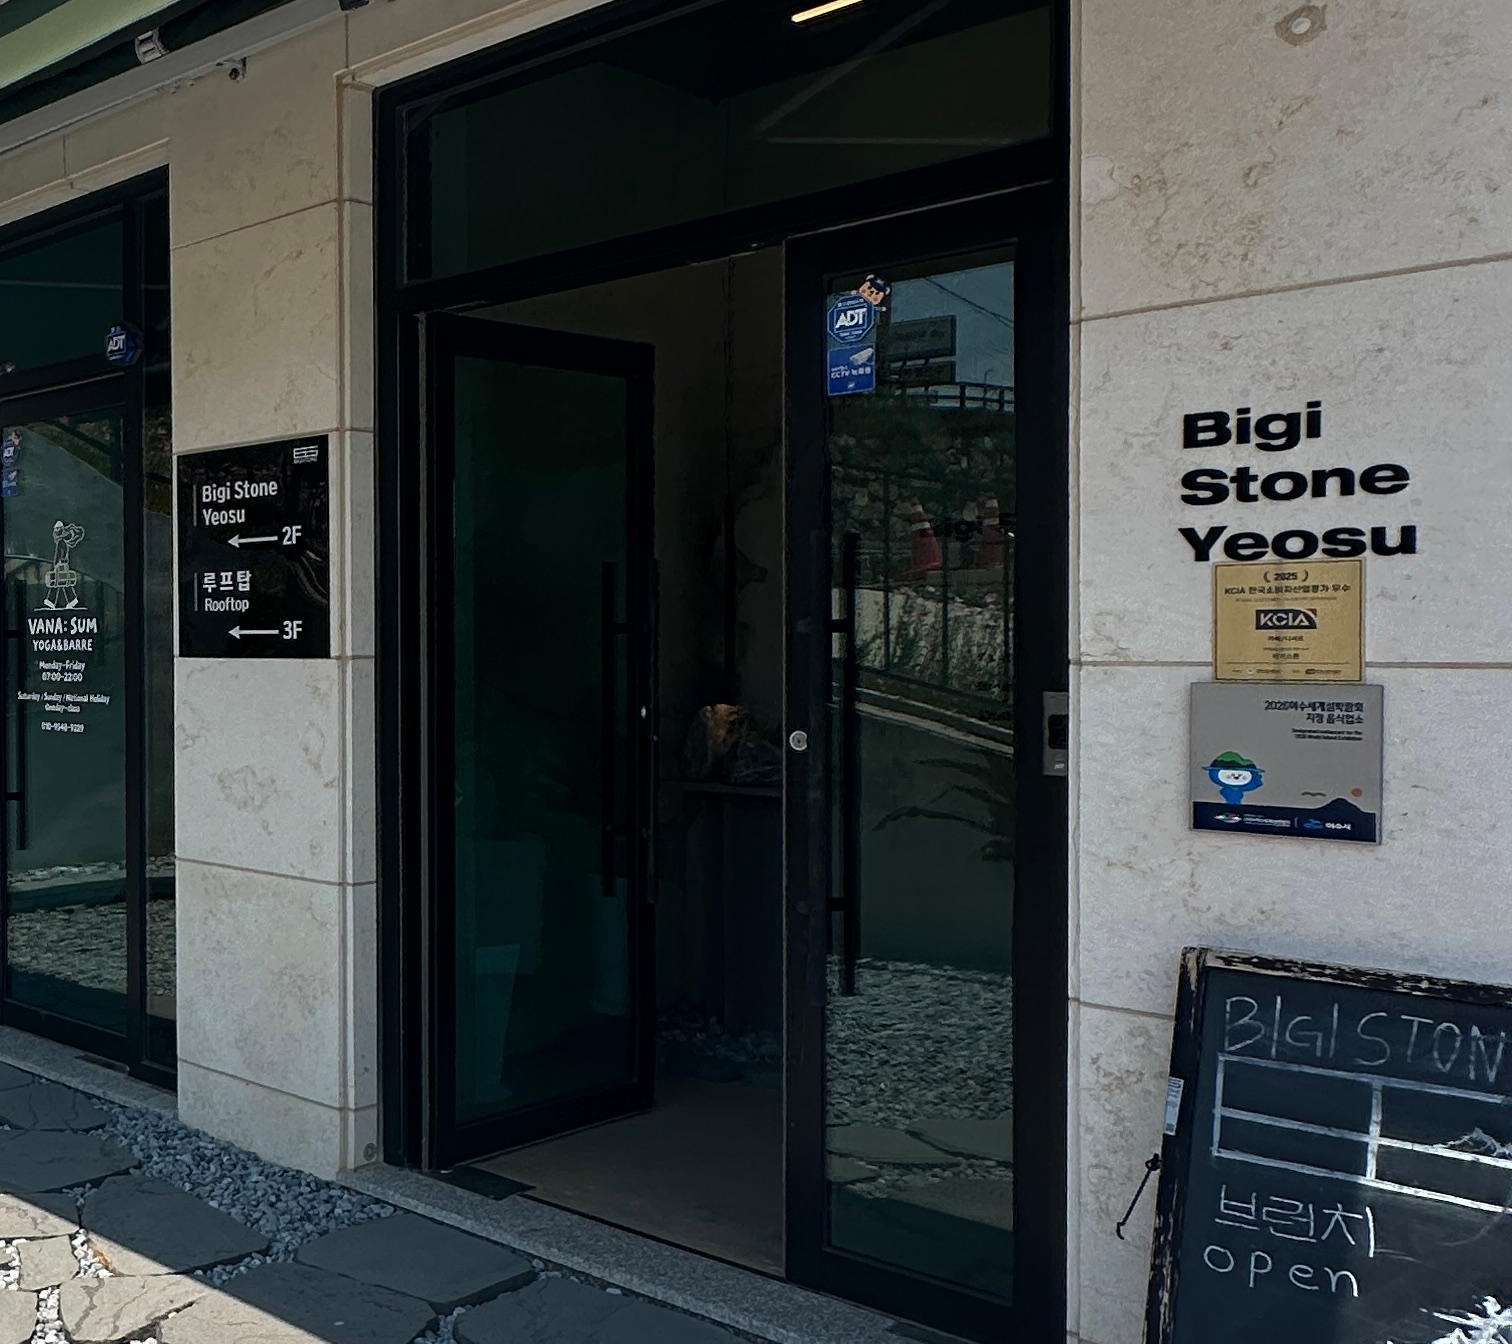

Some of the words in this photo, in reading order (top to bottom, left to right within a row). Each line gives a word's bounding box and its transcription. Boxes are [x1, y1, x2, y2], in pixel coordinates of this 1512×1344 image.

[835, 308, 867, 328] ADT
[107, 335, 126, 352] ADT
[1182, 400, 1322, 452] Bigi
[202, 482, 231, 503] Bigi
[234, 480, 278, 500] Stone
[1180, 462, 1410, 506] Stone
[202, 508, 246, 526] Yeosu
[282, 525, 302, 545] 2F
[1178, 524, 1417, 562] Yeosu
[203, 570, 252, 592] 루프탑
[204, 597, 250, 612] Rooftop
[70, 617, 98, 635] SUM
[1260, 613, 1310, 626] KCIA
[283, 620, 303, 640] 3F
[32, 638, 93, 652] YOGA&BARRE
[1224, 995, 1338, 1058] BIGI
